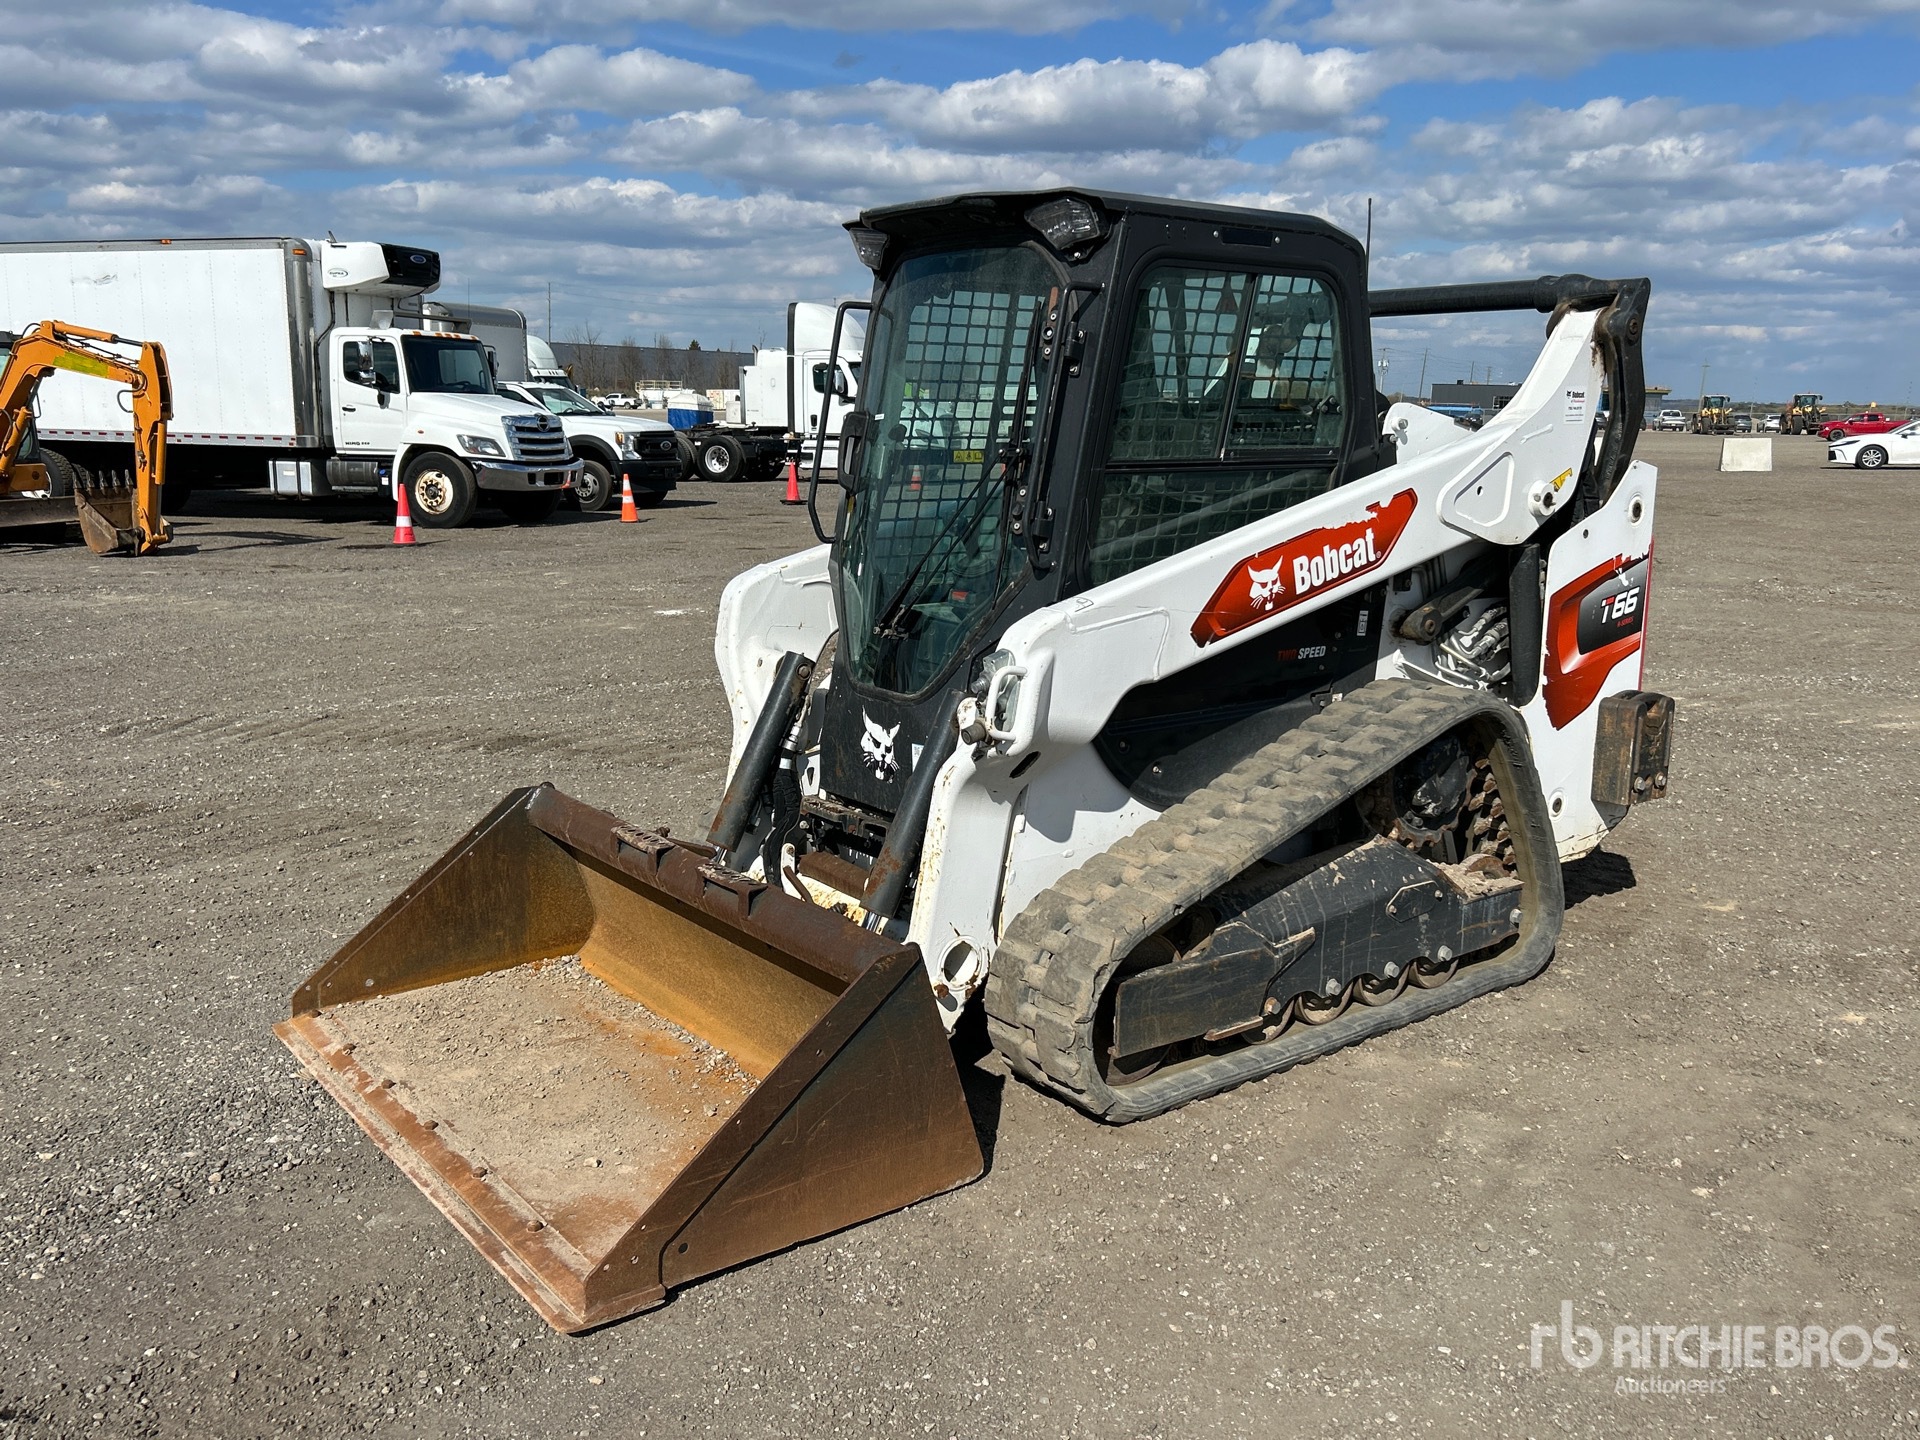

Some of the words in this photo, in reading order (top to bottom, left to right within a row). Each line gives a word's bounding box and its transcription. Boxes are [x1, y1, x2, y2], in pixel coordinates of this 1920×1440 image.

[1293, 527, 1376, 595] Bobcat
[1601, 586, 1640, 624] T66
[1297, 645, 1327, 660] SPEED
